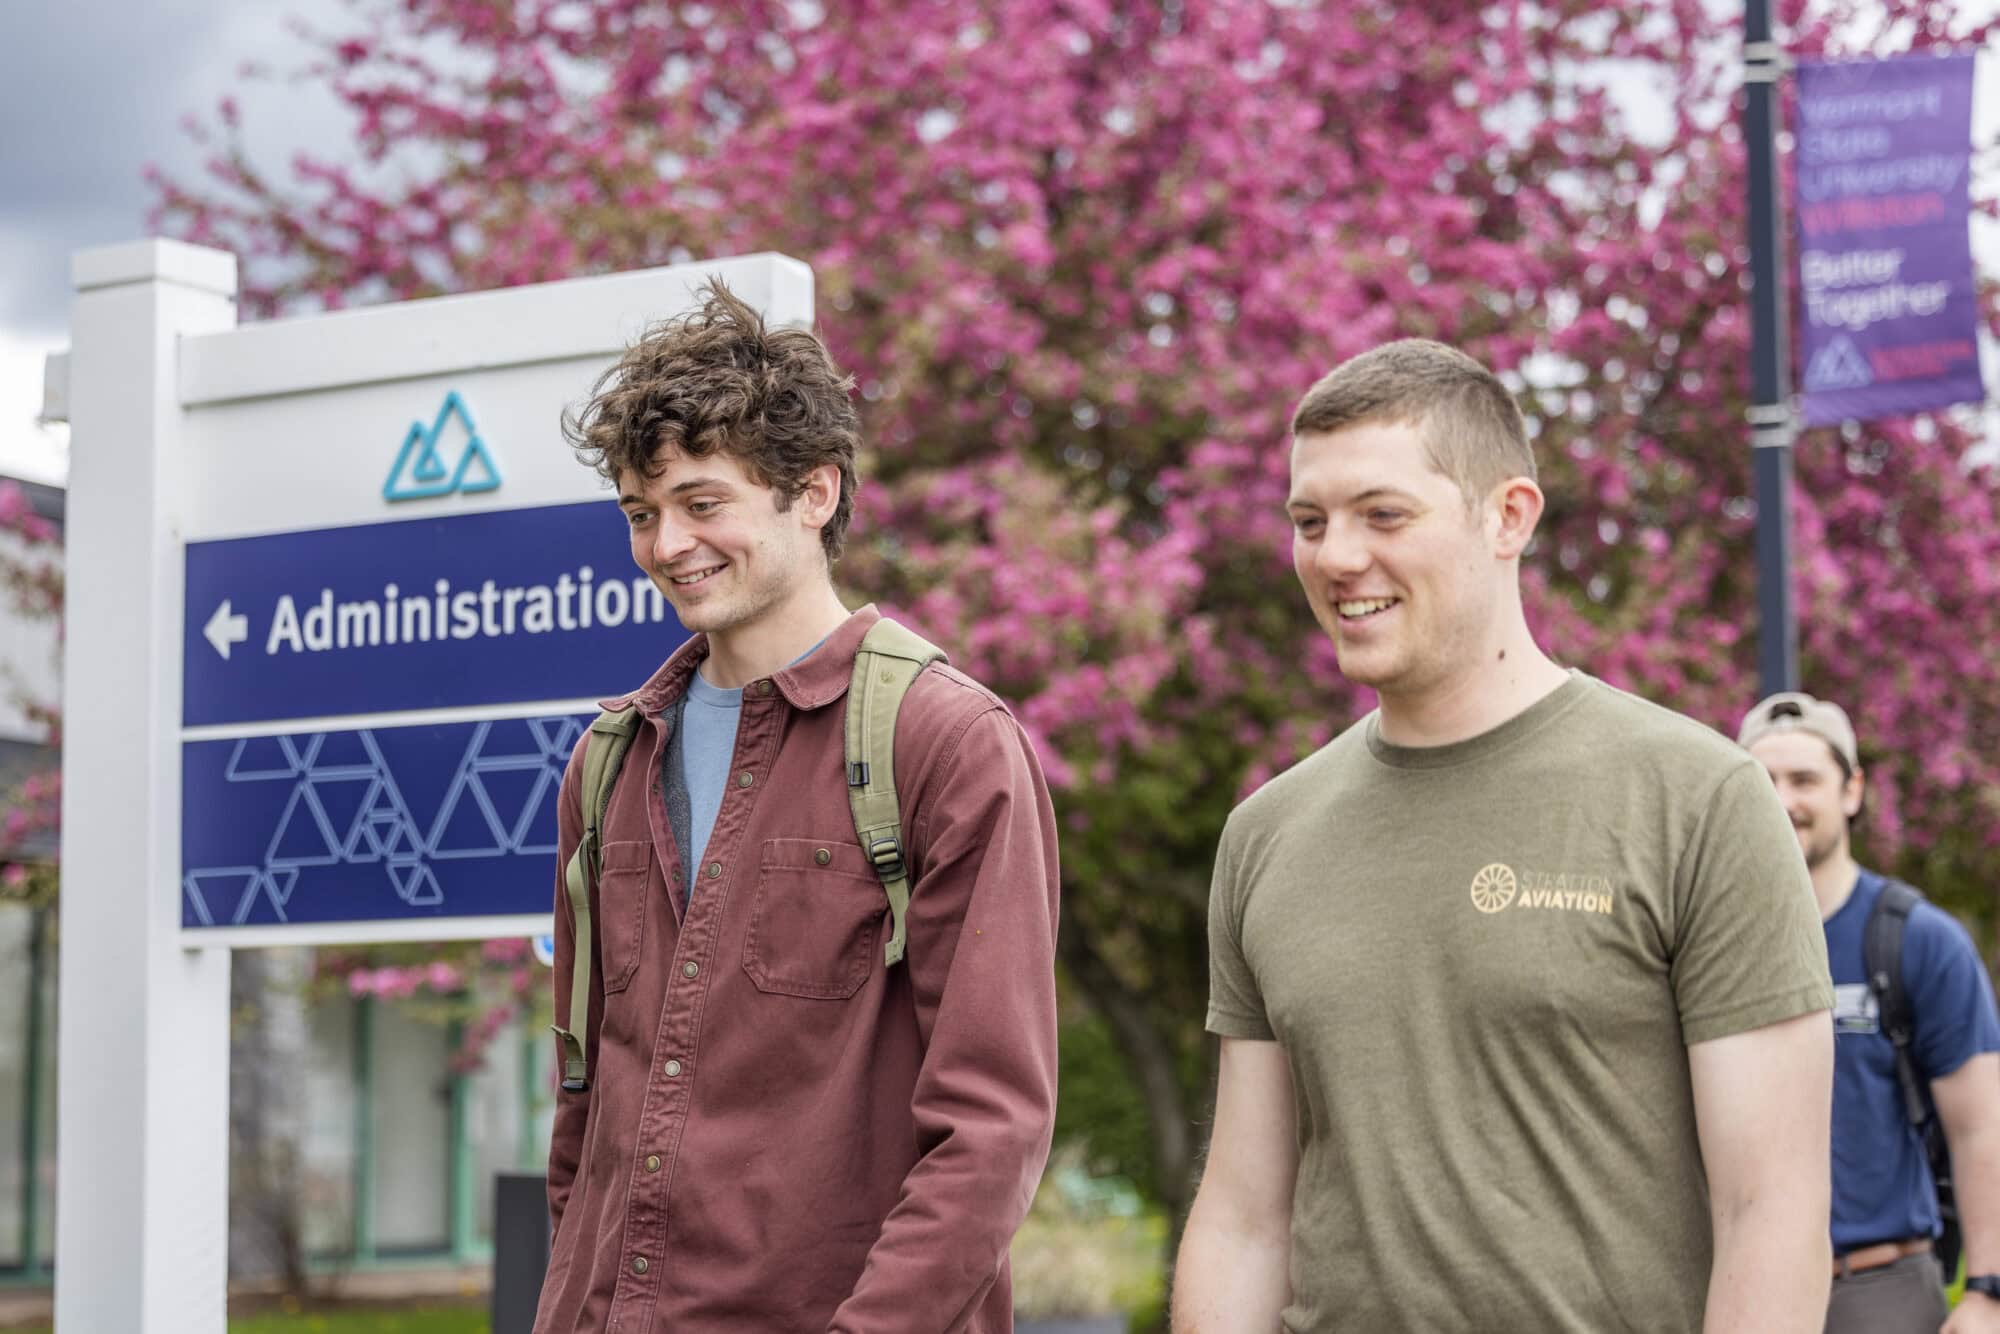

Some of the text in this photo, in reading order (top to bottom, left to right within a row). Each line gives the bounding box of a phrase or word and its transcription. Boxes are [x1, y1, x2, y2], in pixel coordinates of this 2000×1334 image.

[1806, 281, 1950, 330] Together
[266, 566, 664, 655] Administration
[1521, 872, 1615, 895] STRATTON
[1517, 890, 1614, 914] AVIATION
